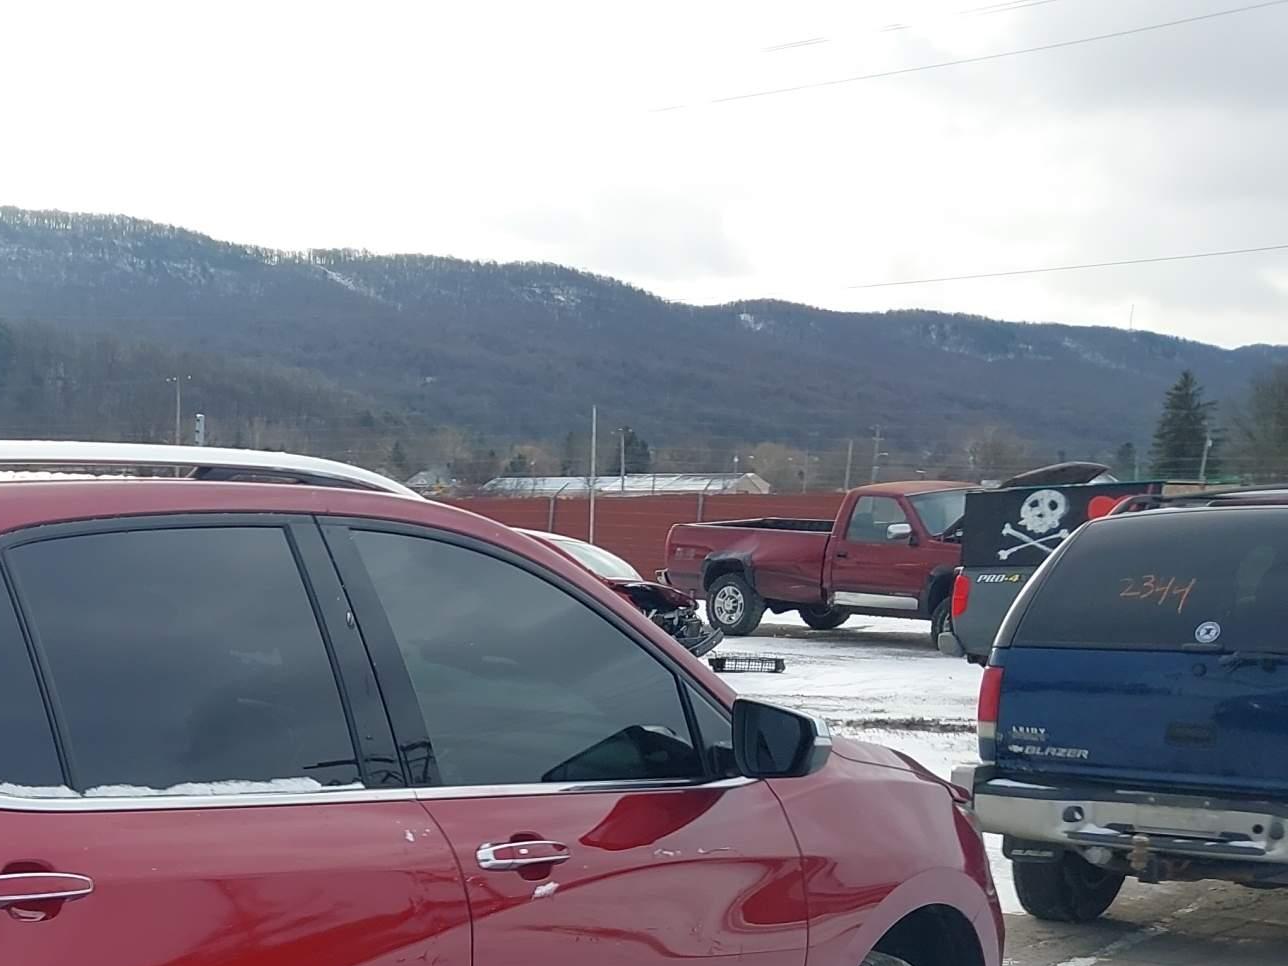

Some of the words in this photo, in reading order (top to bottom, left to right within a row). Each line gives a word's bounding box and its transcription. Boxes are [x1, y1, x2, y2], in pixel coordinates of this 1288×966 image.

[976, 573, 1020, 583] PRO-4
[1119, 574, 1197, 614] 2344
[1024, 745, 1089, 760] BLAZER
